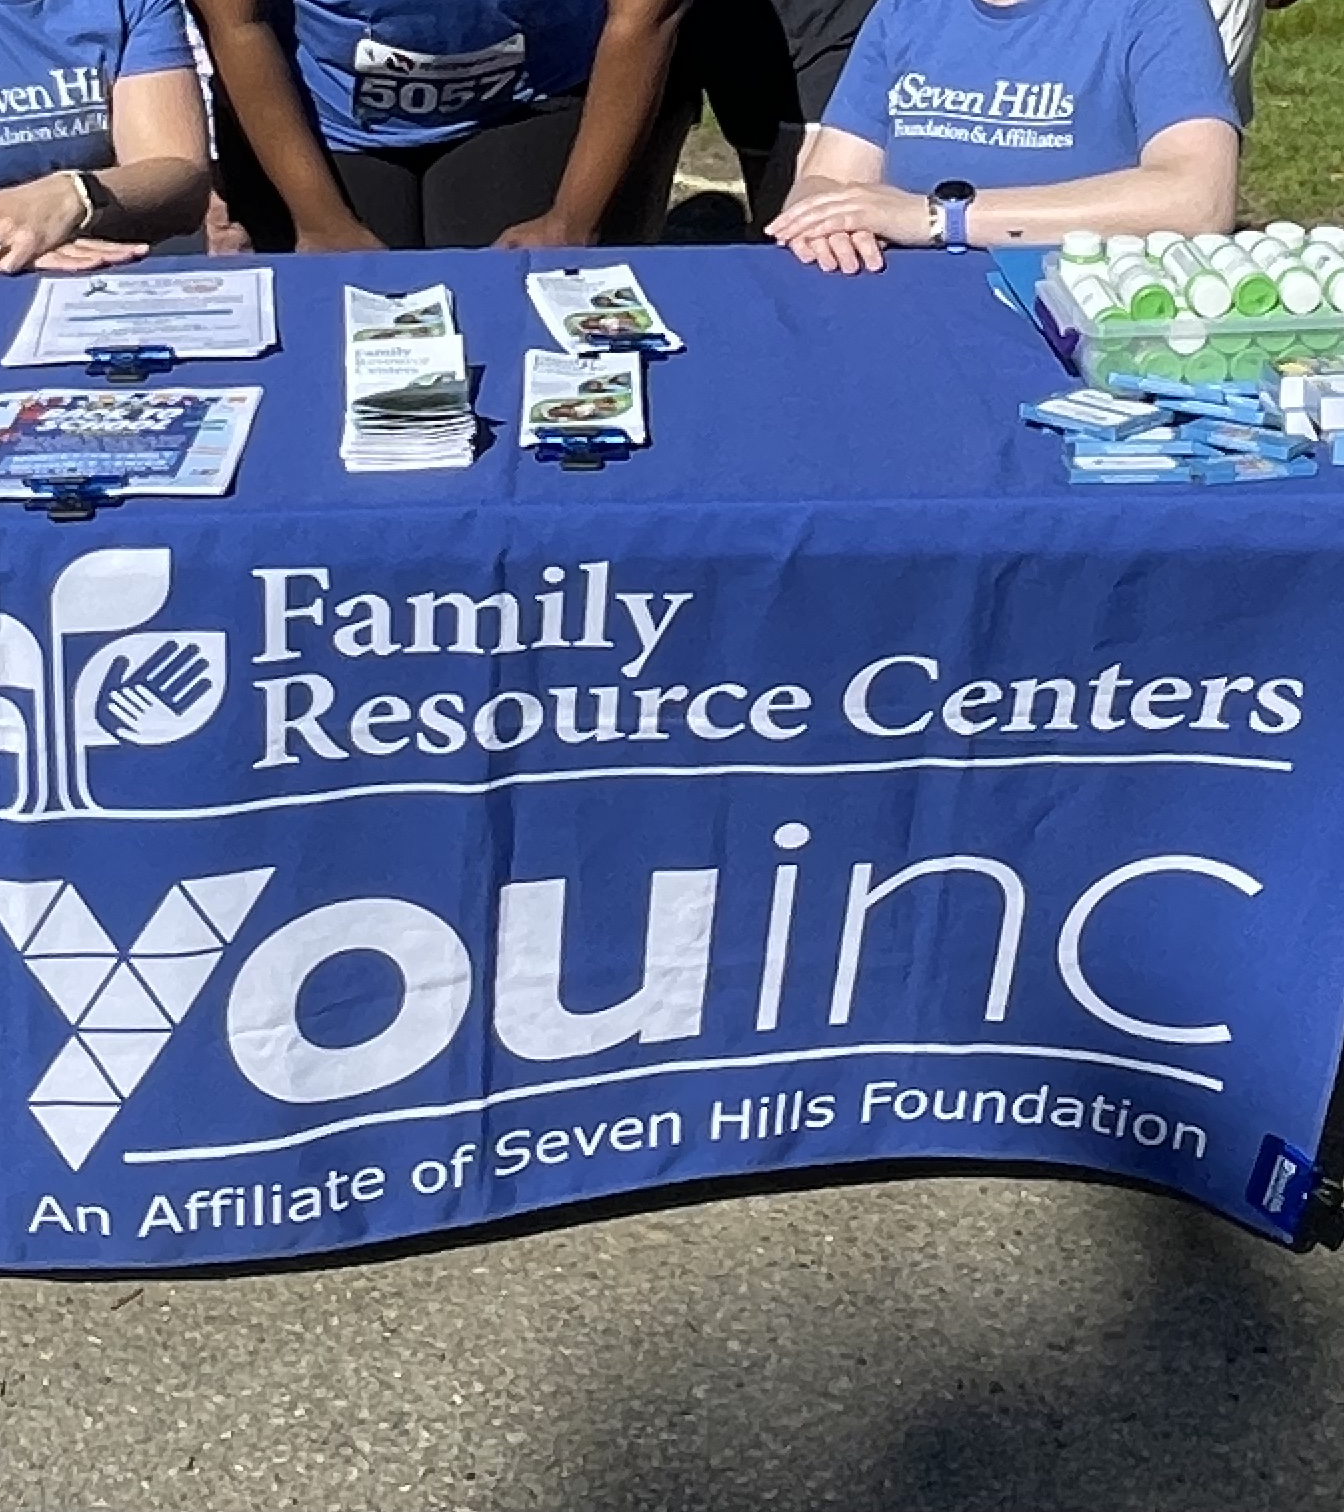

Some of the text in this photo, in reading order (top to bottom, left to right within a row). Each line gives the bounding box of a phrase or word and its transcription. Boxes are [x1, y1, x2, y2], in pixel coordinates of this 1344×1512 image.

[359, 69, 516, 115] 5057
[898, 72, 1074, 119] Seven Hills
[53, 118, 70, 138] &
[894, 117, 1074, 149] Foundation & Affiliates
[252, 560, 694, 679] Family
[252, 654, 1304, 770] Resource Centers
[28, 1080, 1209, 1238] An Affiliate of Seven Hills Foundation
